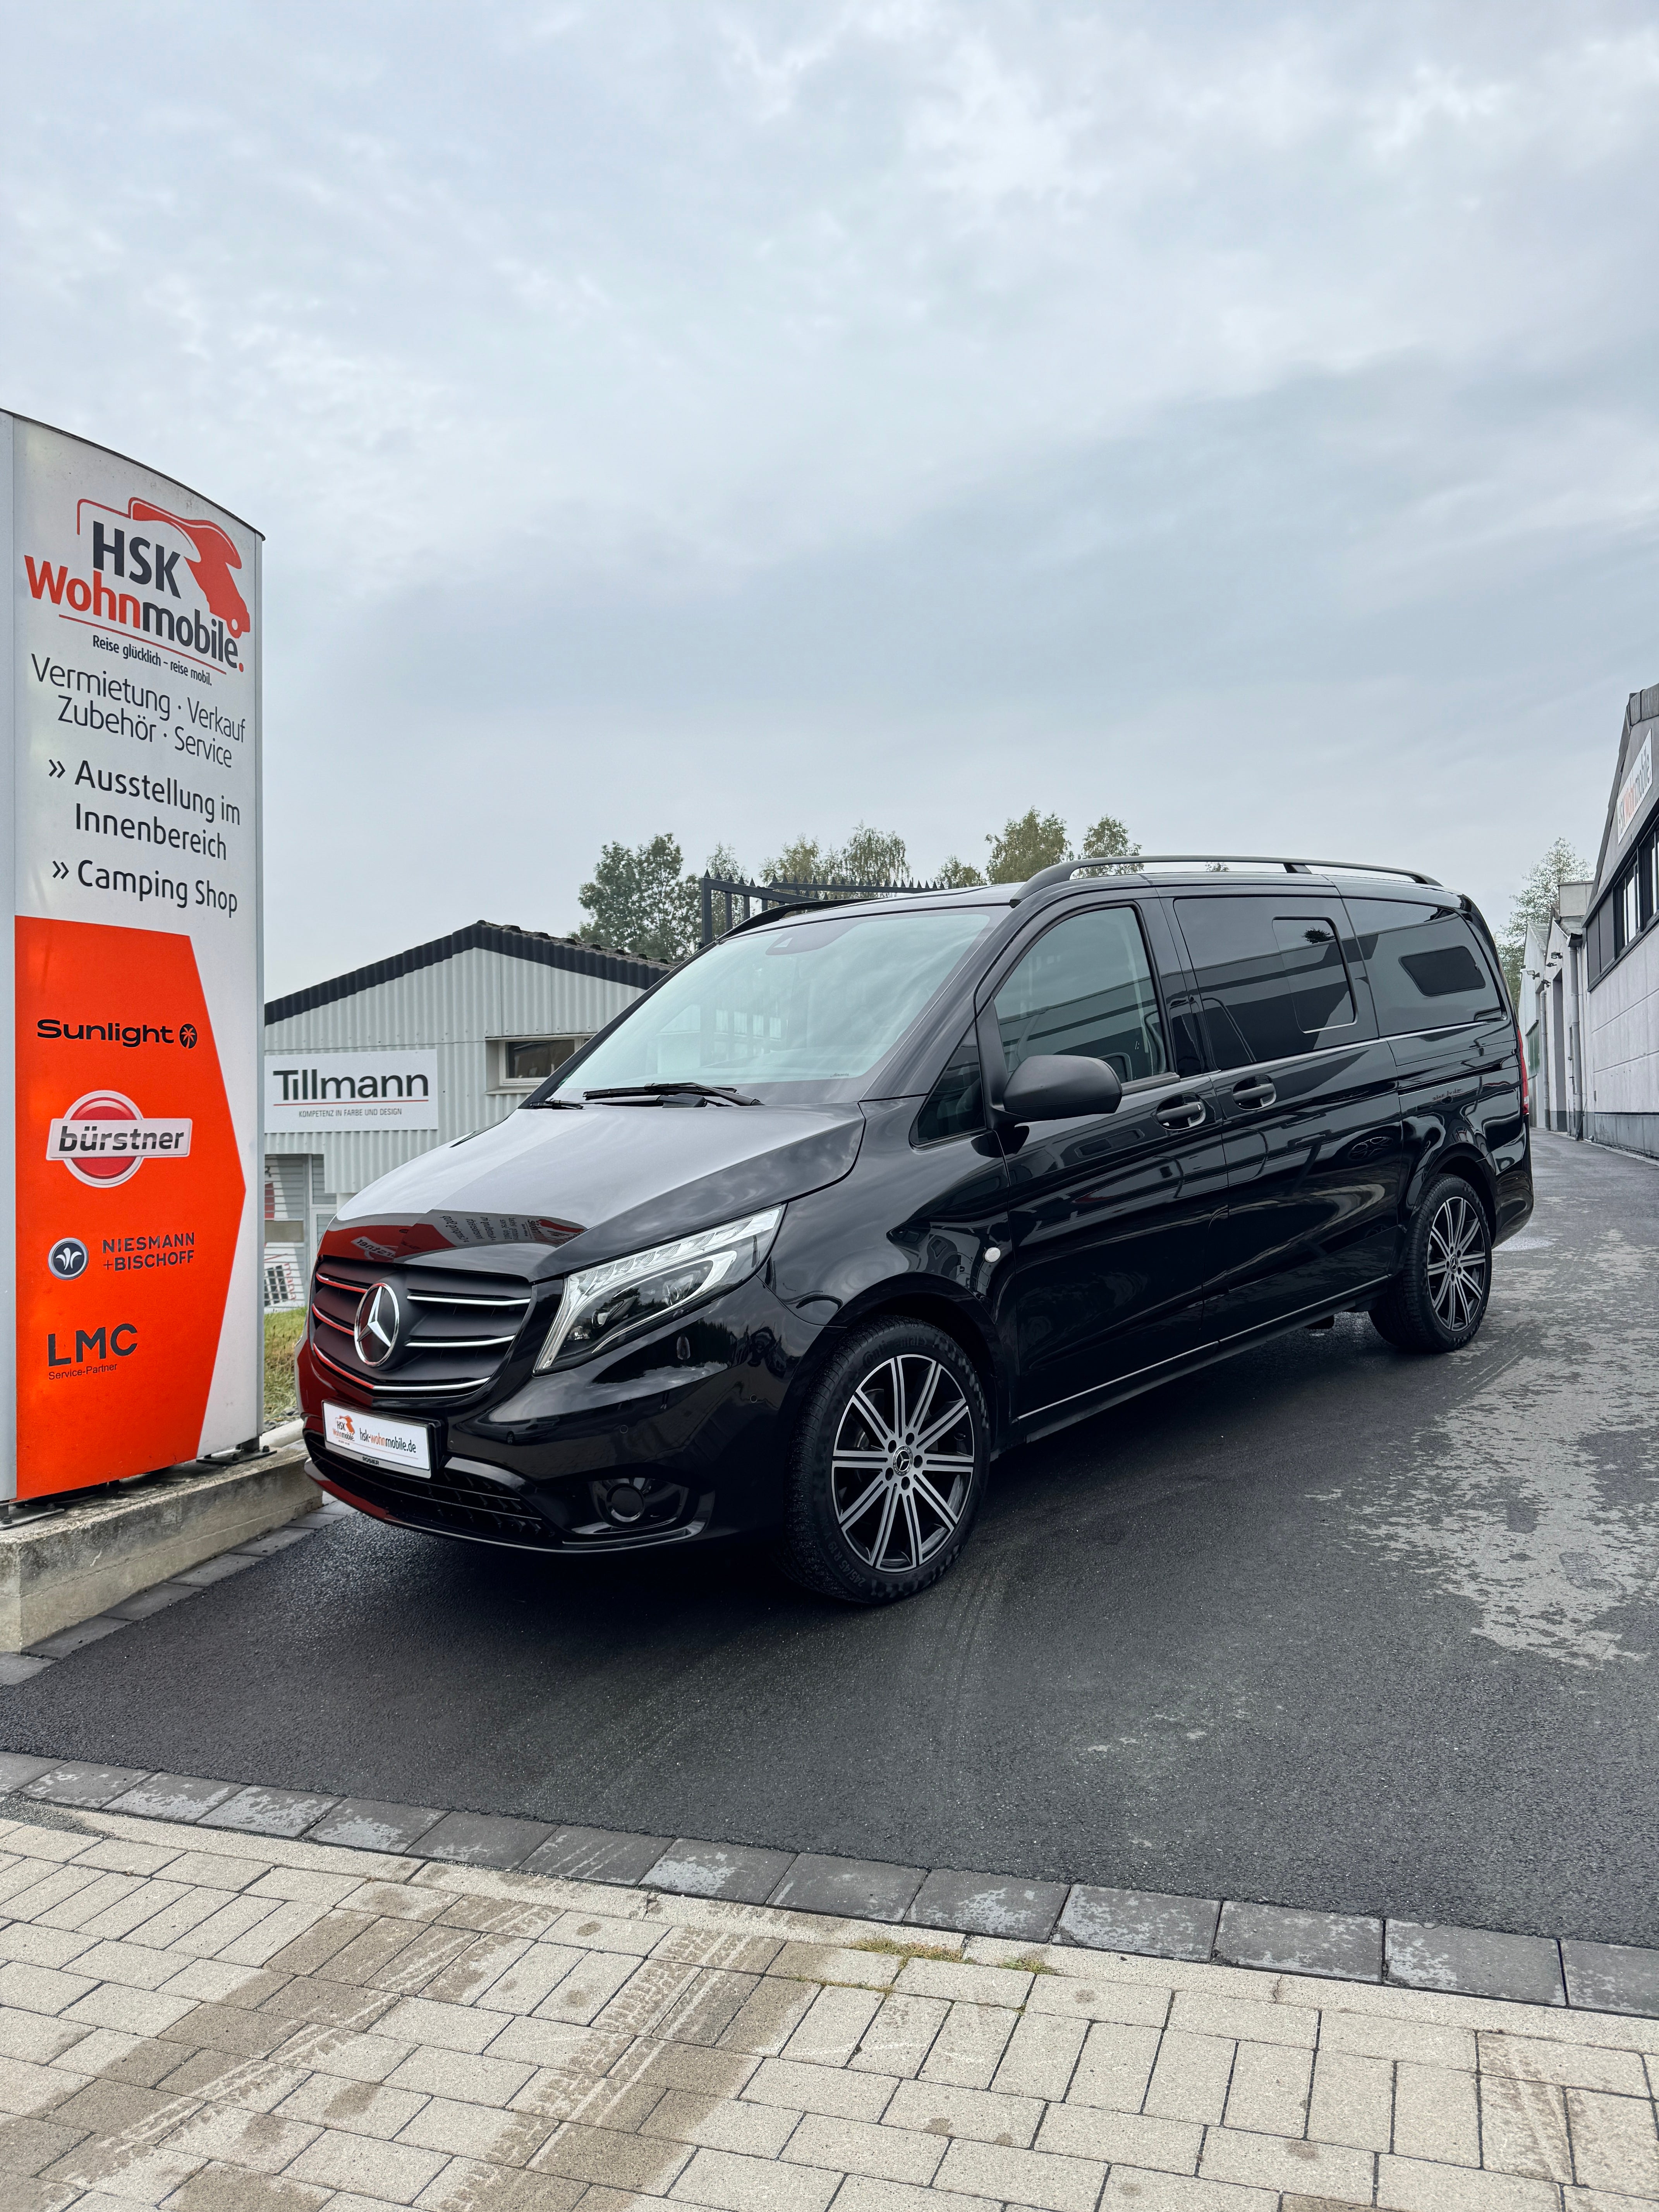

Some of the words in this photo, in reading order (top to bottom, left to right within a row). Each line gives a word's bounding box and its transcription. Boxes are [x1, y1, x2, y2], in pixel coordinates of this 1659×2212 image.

[93, 520, 181, 599] HSK
[24, 555, 244, 672] Wohnmobile.
[93, 635, 119, 653] Reise
[123, 644, 161, 667] glücklich
[170, 660, 188, 676] reise
[191, 668, 212, 686] mobil.
[31, 653, 170, 721] Vermietung
[187, 697, 246, 743] Verkauf
[58, 695, 156, 742] Zubehör
[175, 726, 232, 768] Service
[74, 760, 214, 823] Ausstellung
[221, 795, 240, 825] im
[76, 803, 227, 860] Innenbereich
[77, 860, 187, 908] Camping
[195, 880, 237, 918] Shop
[37, 1019, 174, 1048] Sunlight
[273, 1069, 429, 1101] Tillmann
[299, 1110, 334, 1118] KOMPETENZ
[58, 1126, 184, 1152] bürstner
[102, 1232, 194, 1254] NIESMANN
[48, 1323, 138, 1367] LMC
[48, 1364, 117, 1380] Service-Partner
[337, 1420, 345, 1431] HSK
[359, 1428, 417, 1453] hsk-wohnmobile.de
[362, 1456, 379, 1465] ROSIER
